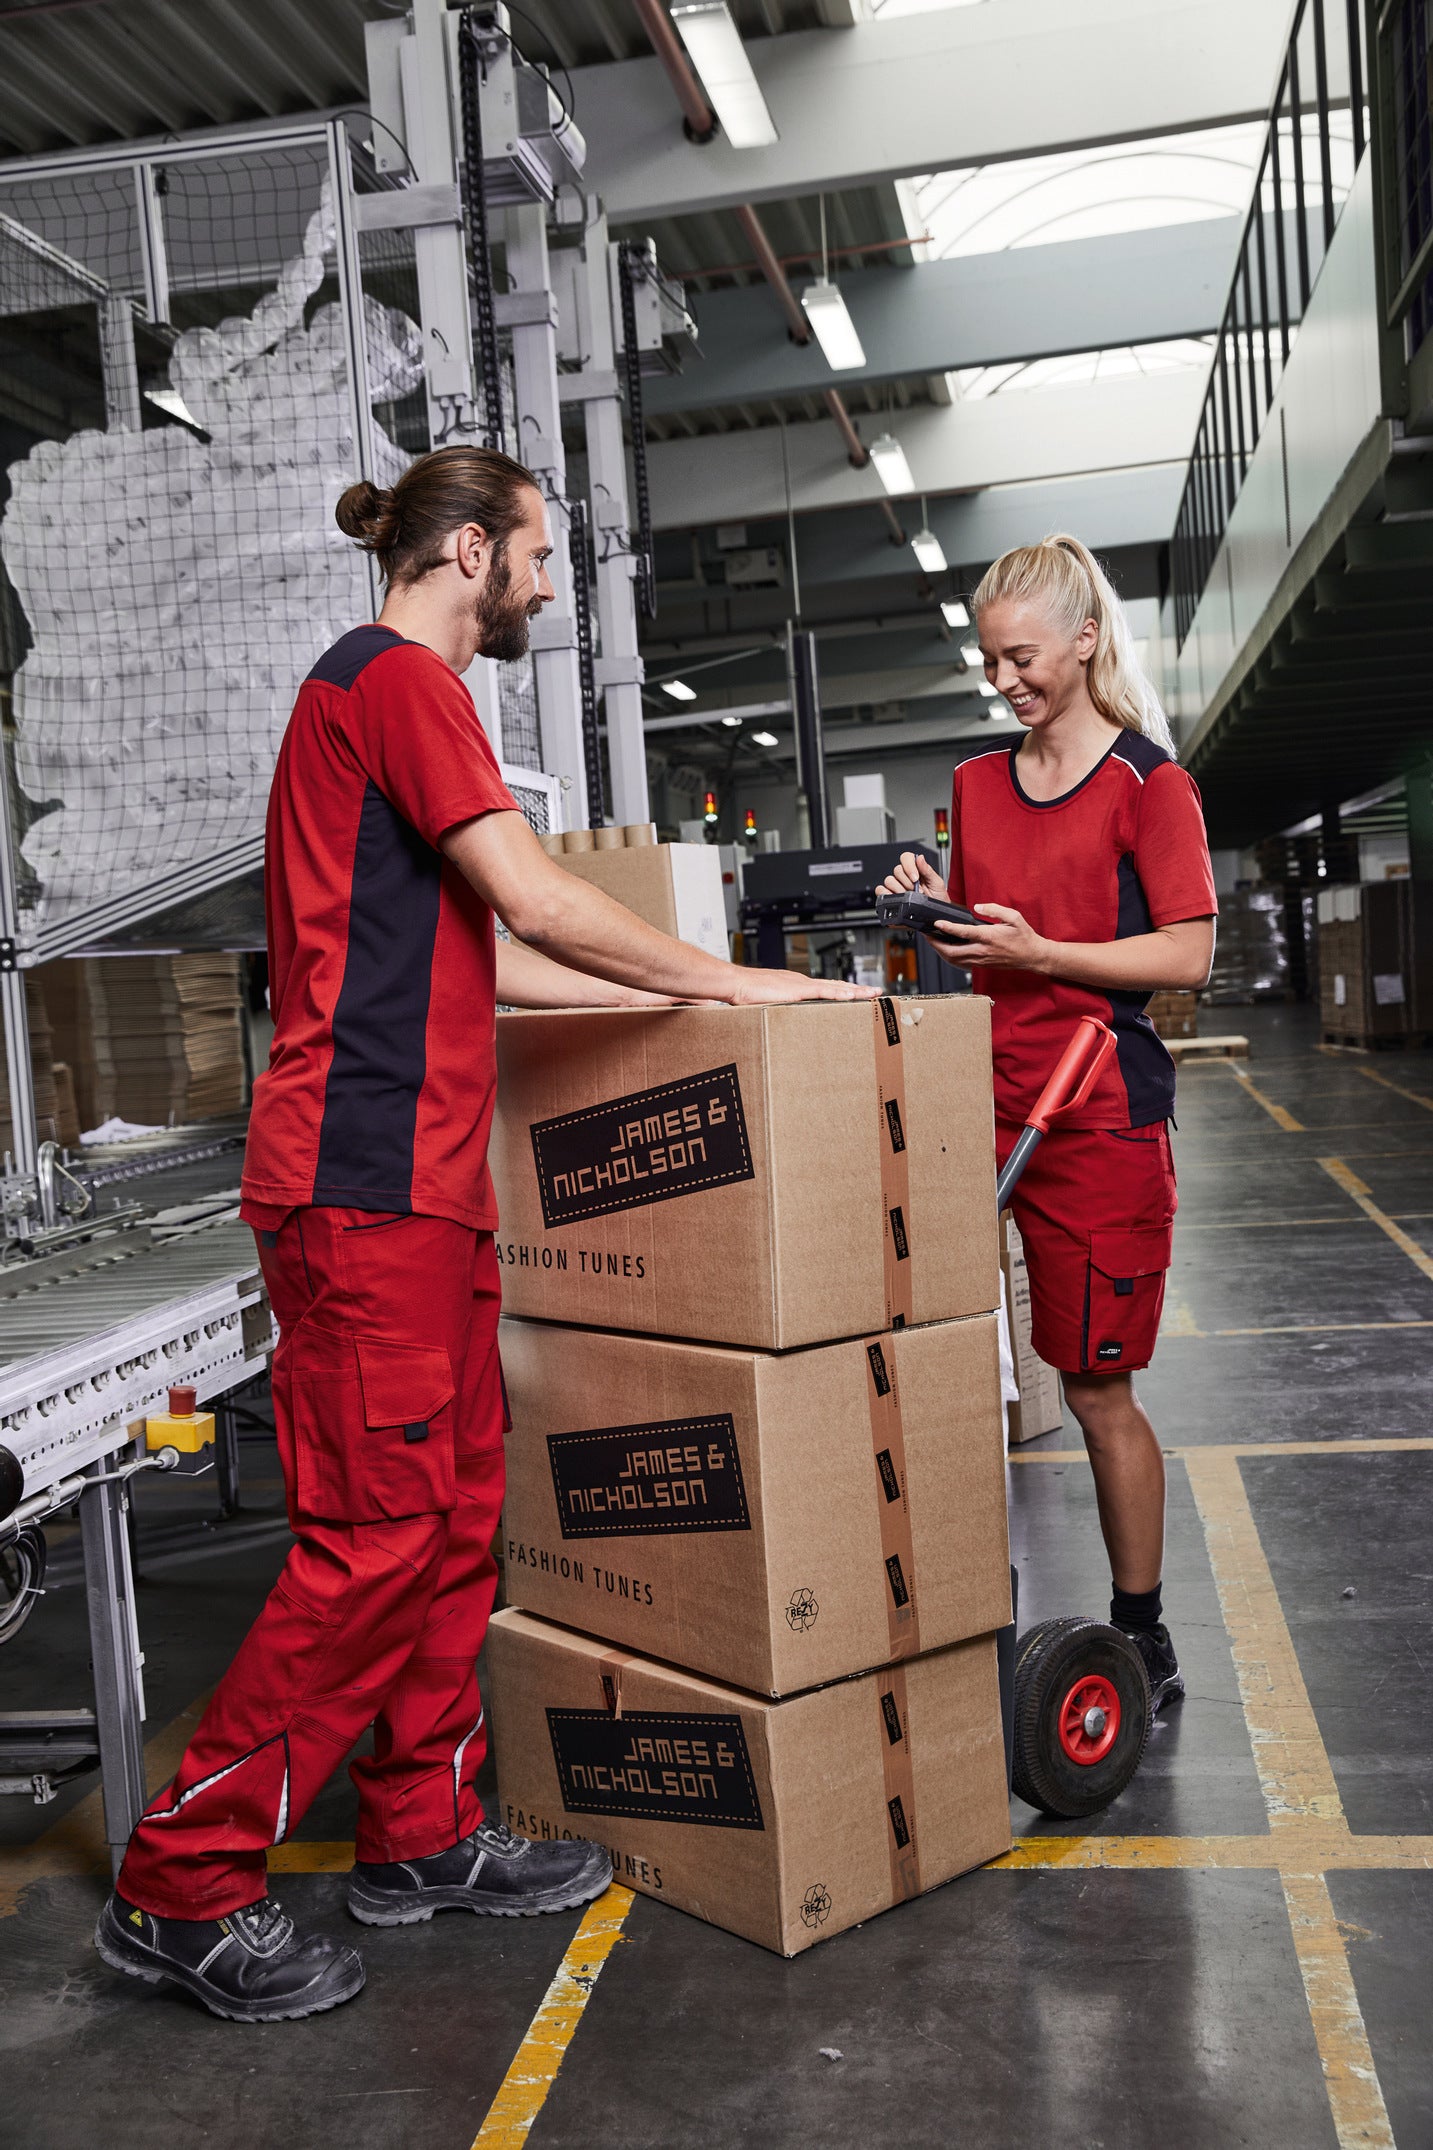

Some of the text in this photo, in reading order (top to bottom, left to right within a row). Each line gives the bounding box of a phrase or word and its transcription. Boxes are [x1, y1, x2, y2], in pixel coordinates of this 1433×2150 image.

[610, 1097, 728, 1153] JAMES &
[553, 1137, 707, 1200] NICHOLSON
[495, 1243, 645, 1278] ASHION TUNES
[619, 1444, 725, 1478] JAMES &
[568, 1479, 708, 1513] NICHOLSON
[508, 1540, 653, 1606] FASHION TUNES
[624, 1737, 735, 1768] JAMES &
[570, 1765, 718, 1800] NICHOLSON
[601, 1845, 663, 1889] UNES
